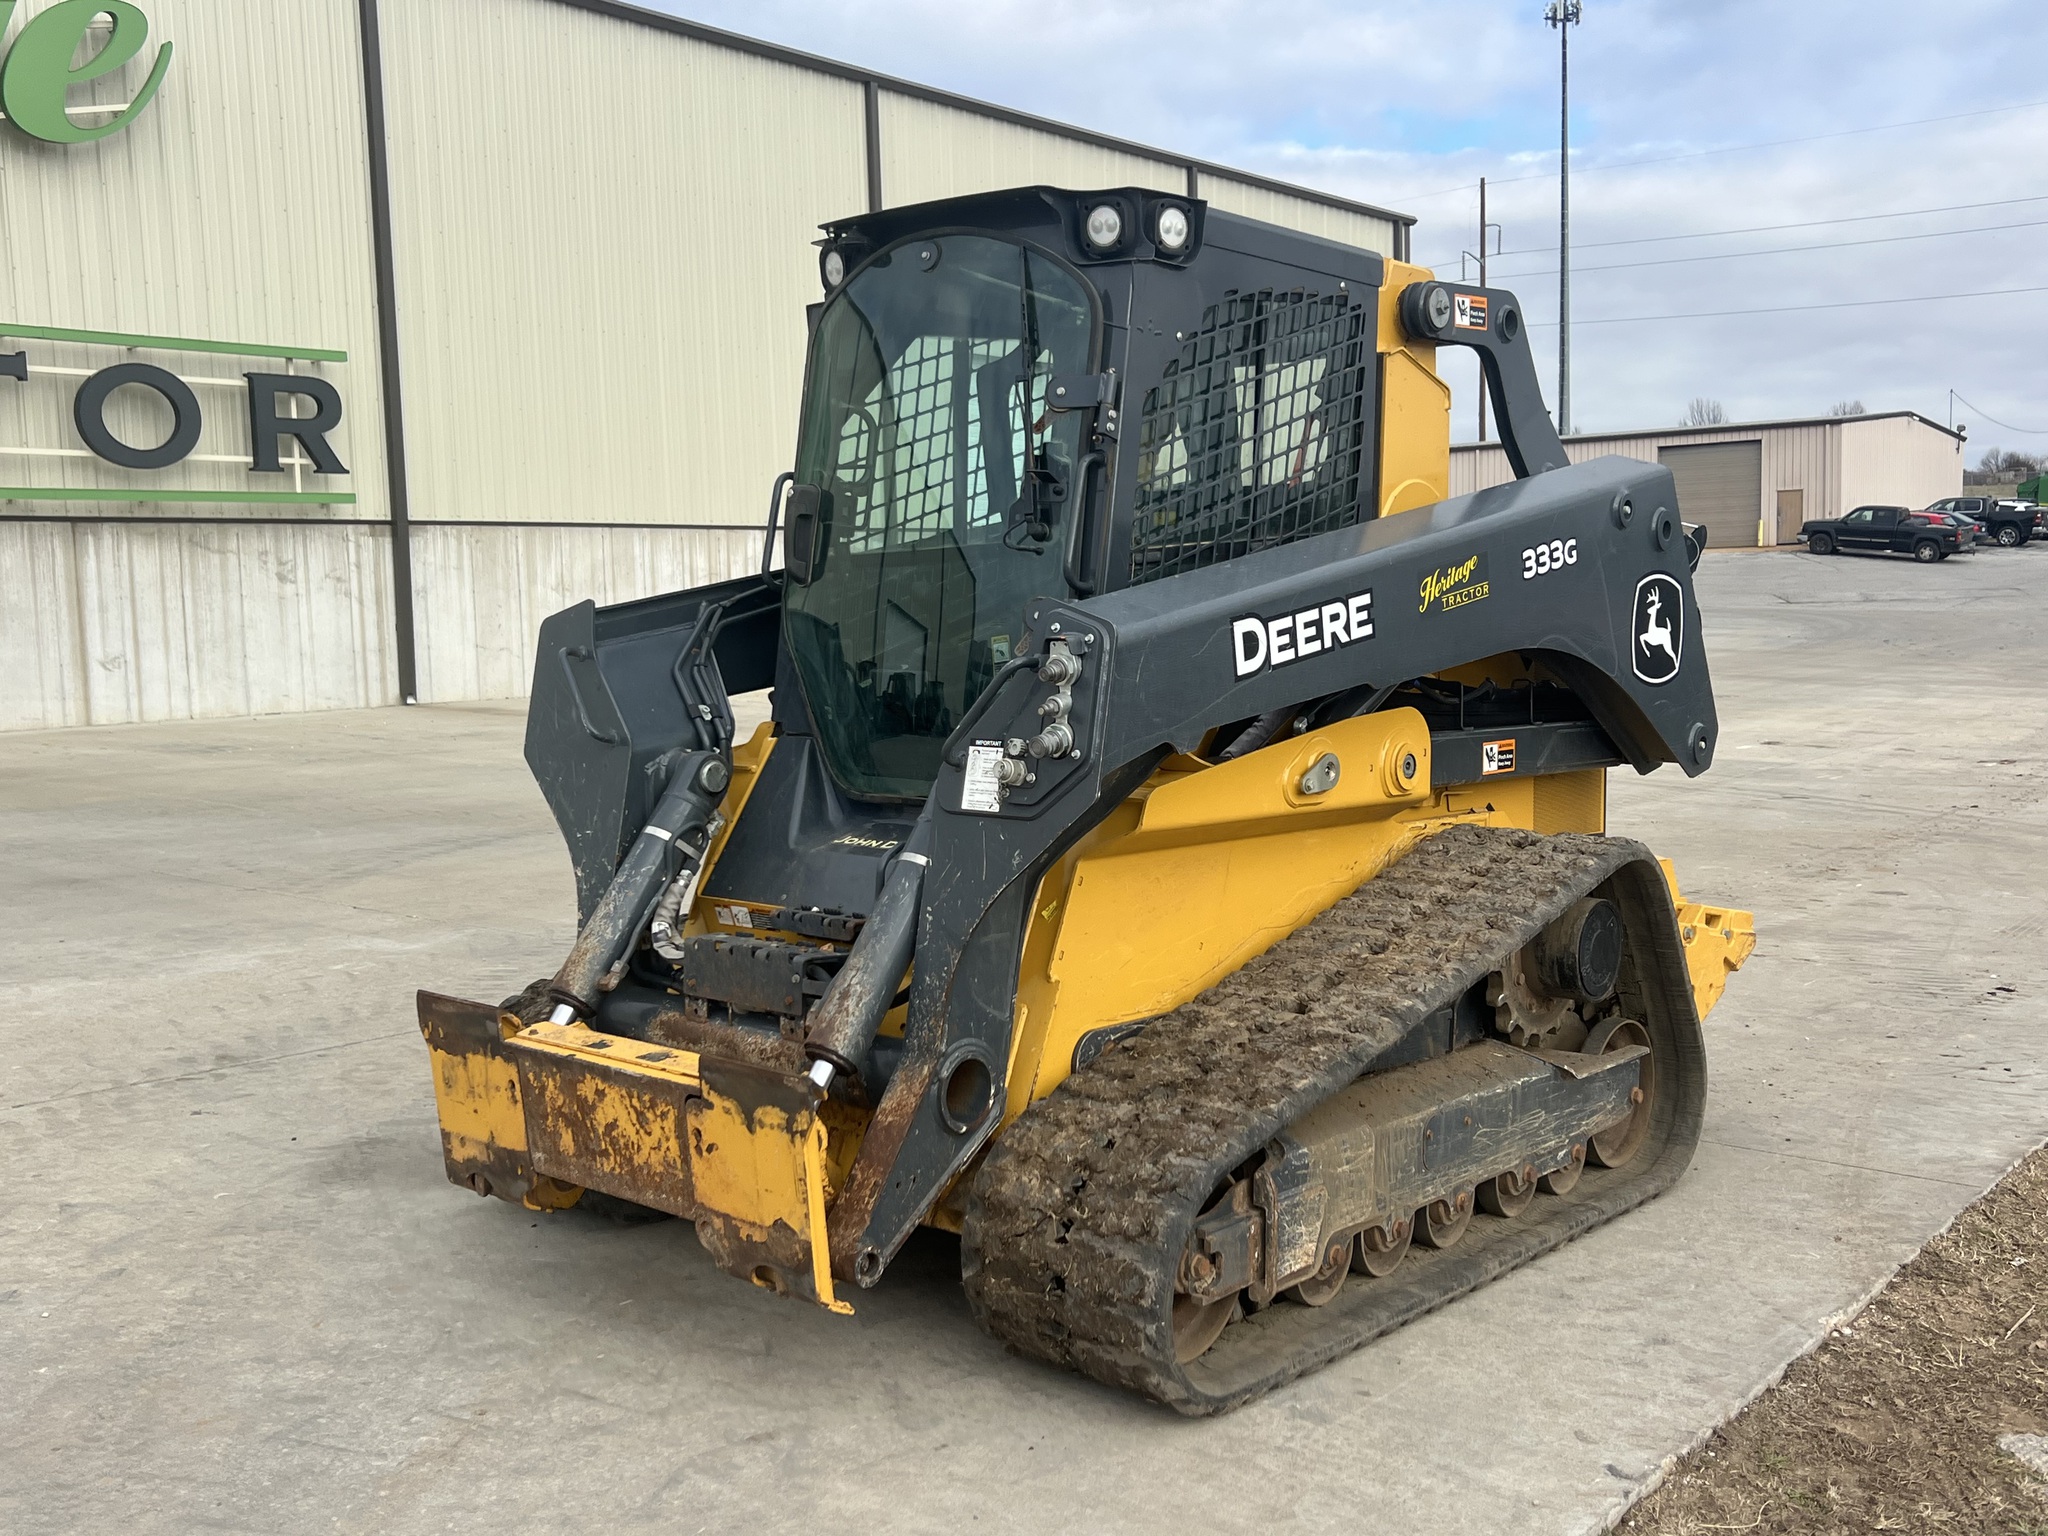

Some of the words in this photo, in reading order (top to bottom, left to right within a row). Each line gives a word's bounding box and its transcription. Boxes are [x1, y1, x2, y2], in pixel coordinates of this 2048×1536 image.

[0, 0, 173, 143] e
[1419, 555, 1478, 613] Heritage
[1522, 538, 1578, 580] 333G
[1442, 584, 1489, 609] TRACTOR
[1233, 593, 1373, 676] DEERE
[833, 835, 884, 848] JOHN
